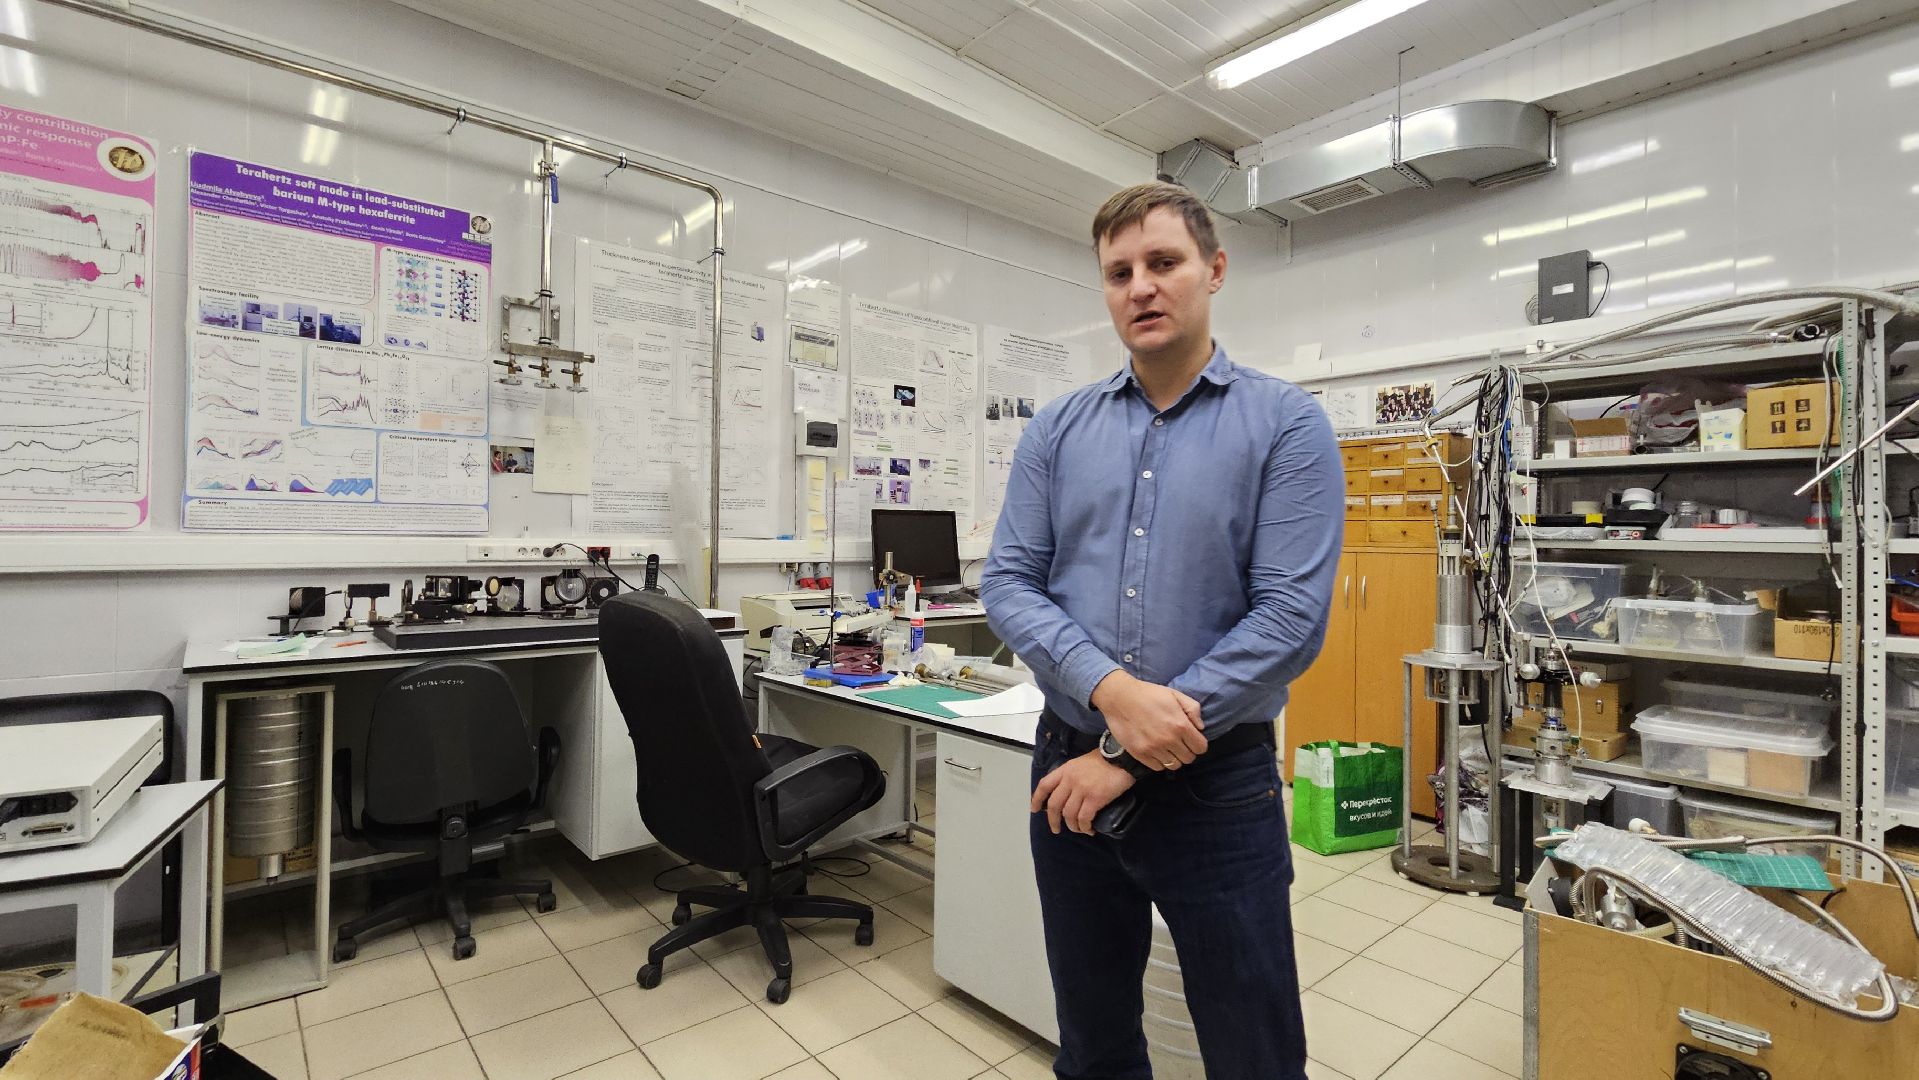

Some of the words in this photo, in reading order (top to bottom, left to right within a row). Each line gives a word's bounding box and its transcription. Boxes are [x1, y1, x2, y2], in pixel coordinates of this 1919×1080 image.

[16, 113, 109, 138] contribution
[26, 128, 92, 148] response
[236, 164, 292, 185] Terahertz
[295, 180, 317, 190] soft
[320, 184, 349, 198] mode
[352, 190, 362, 201] in
[366, 192, 446, 219] lead-substituted
[194, 211, 220, 220] Abstract
[272, 186, 314, 204] barium
[318, 196, 356, 213] M-type
[358, 204, 416, 225] hexaferrite
[198, 286, 237, 297] Spectroscopy
[1350, 812, 1371, 822] вкусов
